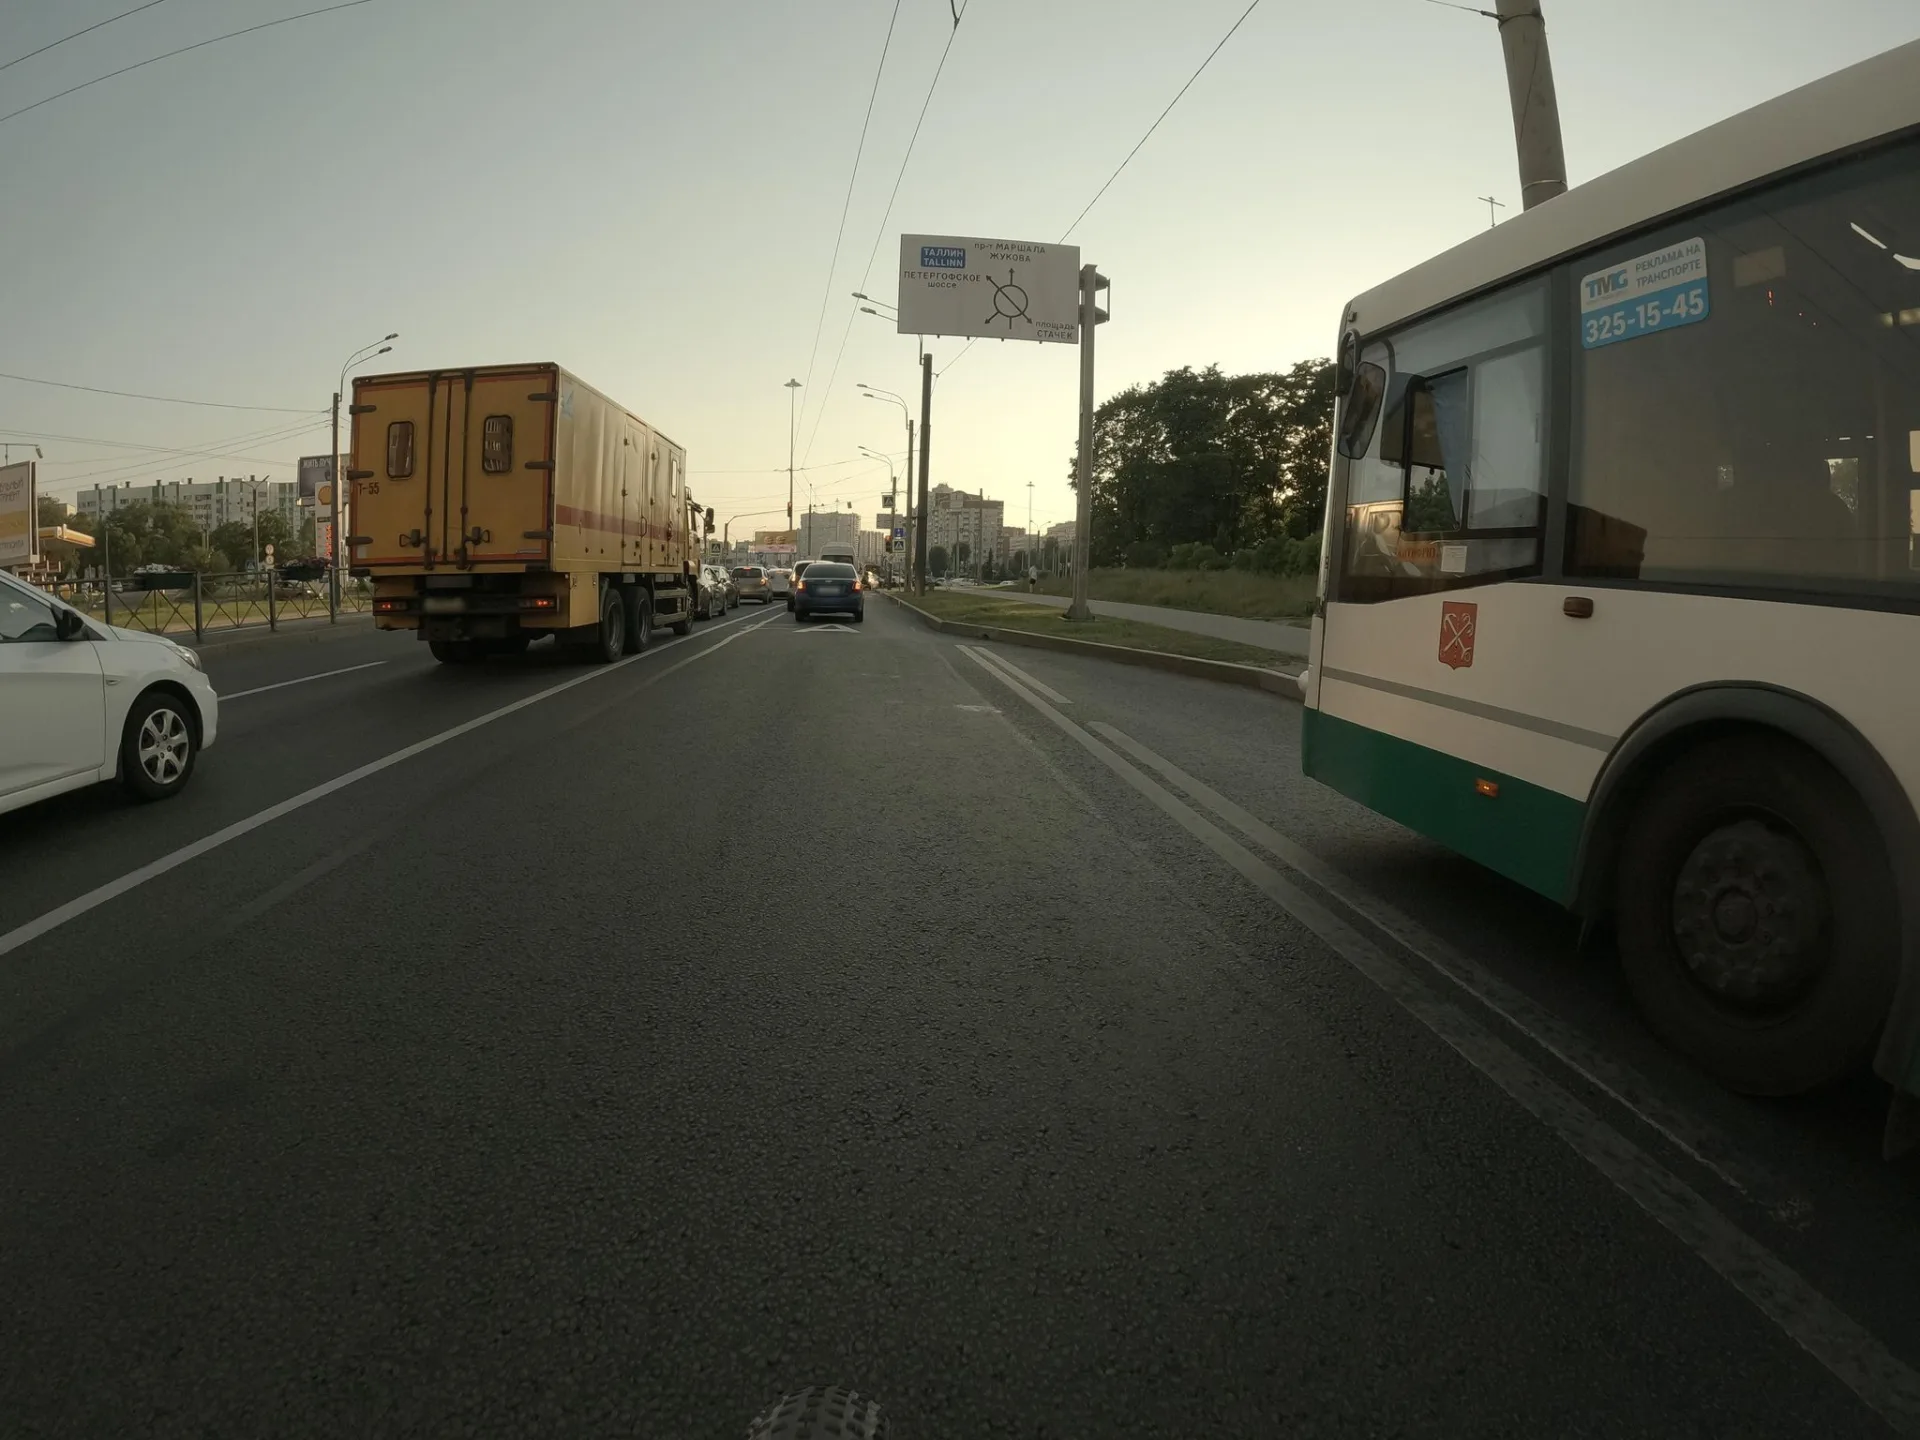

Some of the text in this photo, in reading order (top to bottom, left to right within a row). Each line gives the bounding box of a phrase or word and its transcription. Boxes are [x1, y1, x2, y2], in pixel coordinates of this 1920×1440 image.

[923, 248, 964, 257] ТАЛЛИН
[995, 243, 1046, 254] МАРШАЛА
[923, 257, 963, 267] TALLINN
[990, 252, 1031, 262] ЖУКОВА
[1635, 244, 1701, 273] РЕКЛАМА НА
[904, 271, 981, 282] ПЕТЕРГОФСКОЕ
[1635, 259, 1701, 289] ТРАНСПОРТЕ
[1585, 288, 1705, 343] 325-15-45
[1035, 321, 1075, 331] площадь
[1036, 330, 1073, 340] СТАЧЕК
